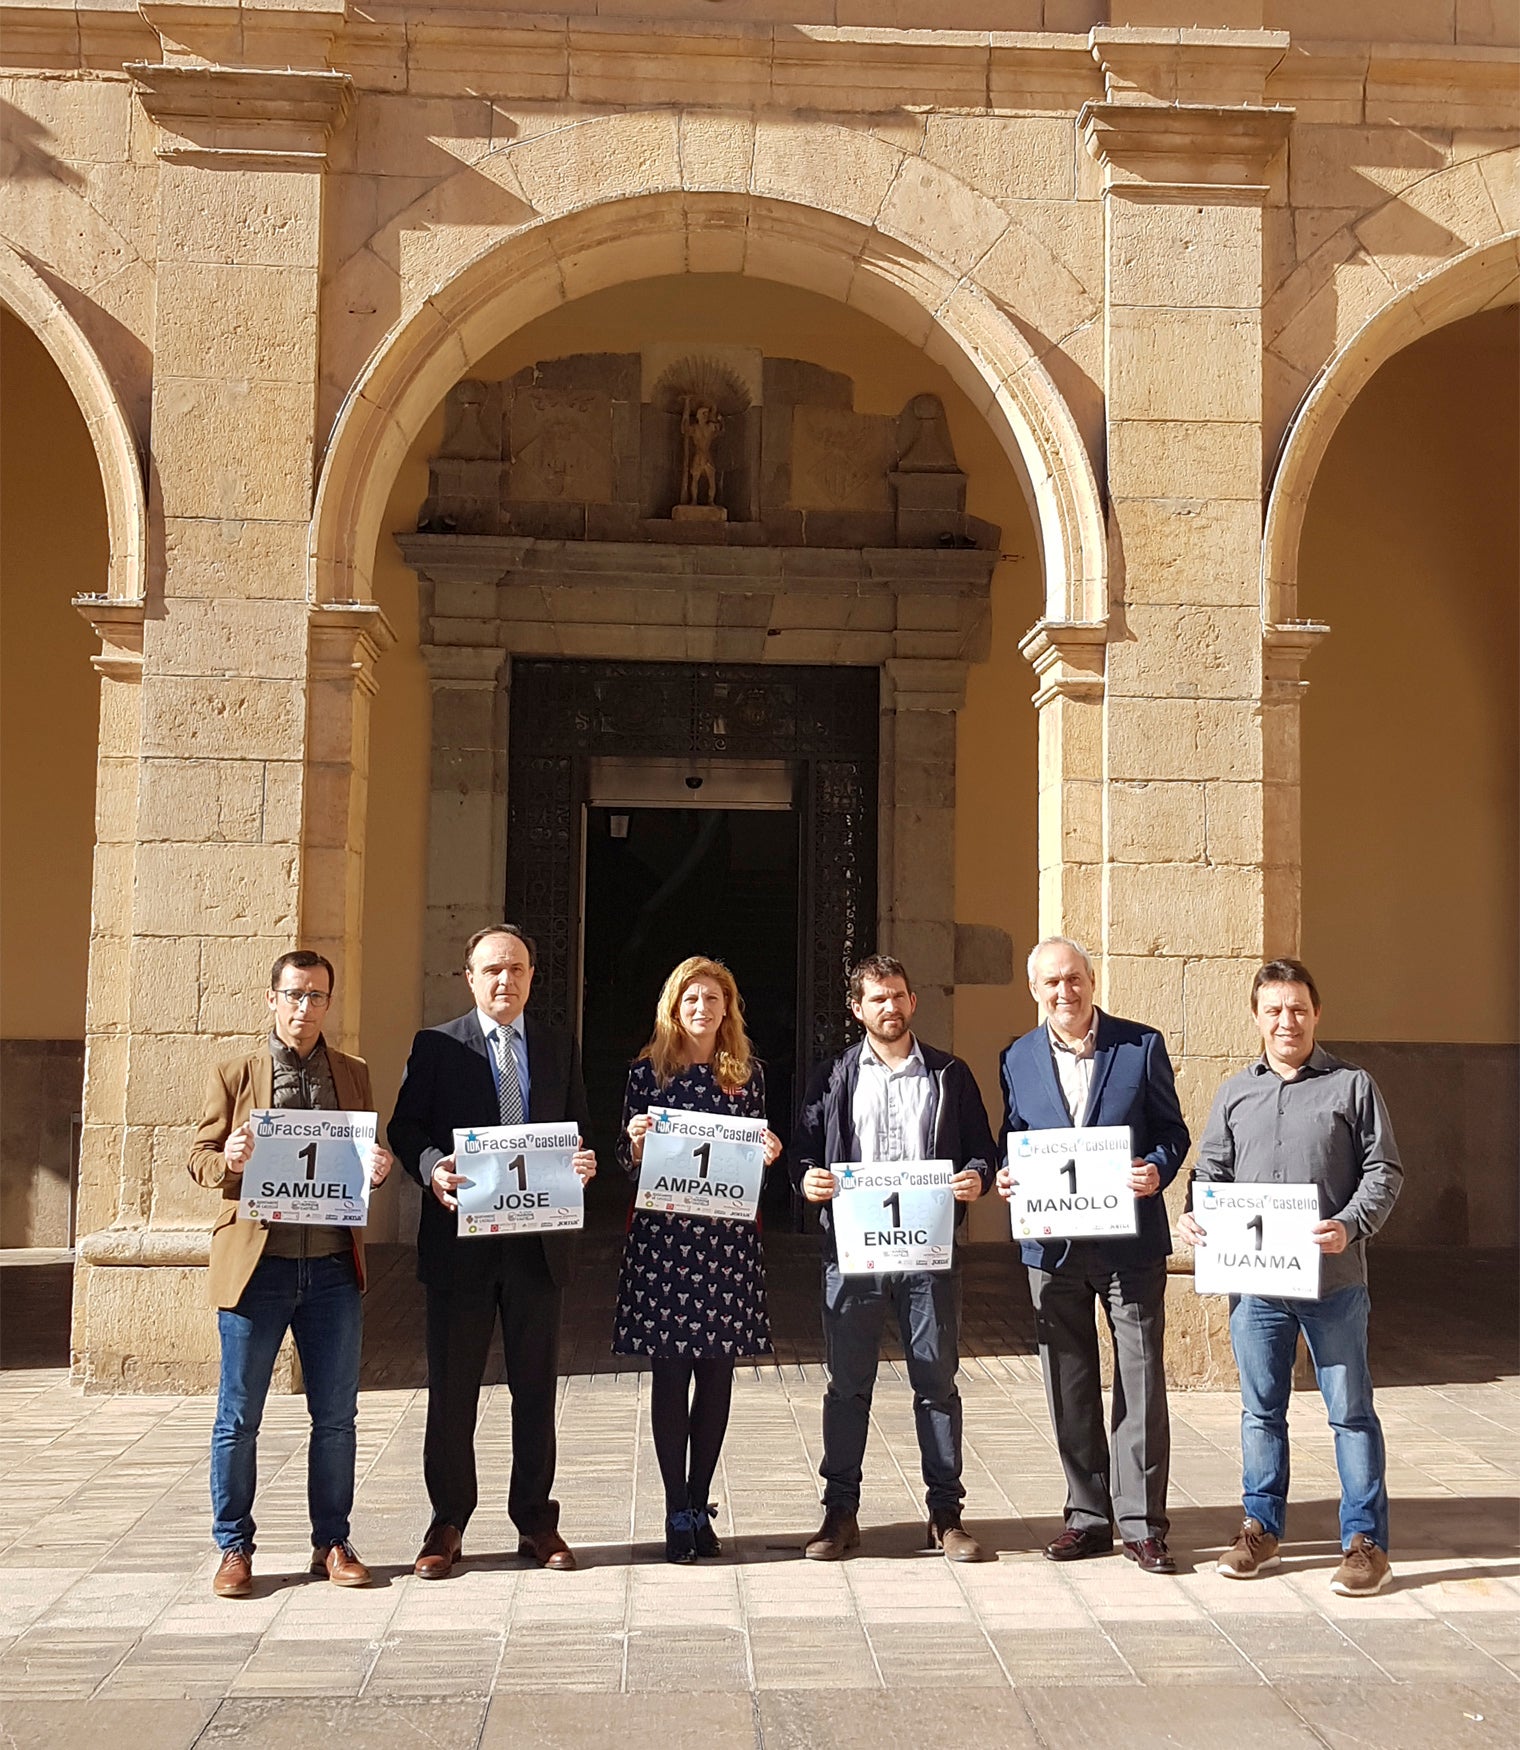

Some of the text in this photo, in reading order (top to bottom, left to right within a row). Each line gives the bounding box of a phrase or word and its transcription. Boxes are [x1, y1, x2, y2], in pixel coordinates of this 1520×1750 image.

[298, 1142, 318, 1180] 1
[508, 1154, 527, 1191] 1
[693, 1142, 711, 1179] 1
[1060, 1159, 1077, 1194] 1
[260, 1181, 354, 1199] SAMUEL
[493, 1192, 550, 1210] JOSE
[654, 1176, 745, 1199] AMPARO
[1027, 1195, 1118, 1212] MANOLO
[882, 1192, 901, 1228] 1
[864, 1230, 928, 1246] ENRIC
[1246, 1214, 1263, 1251] 1
